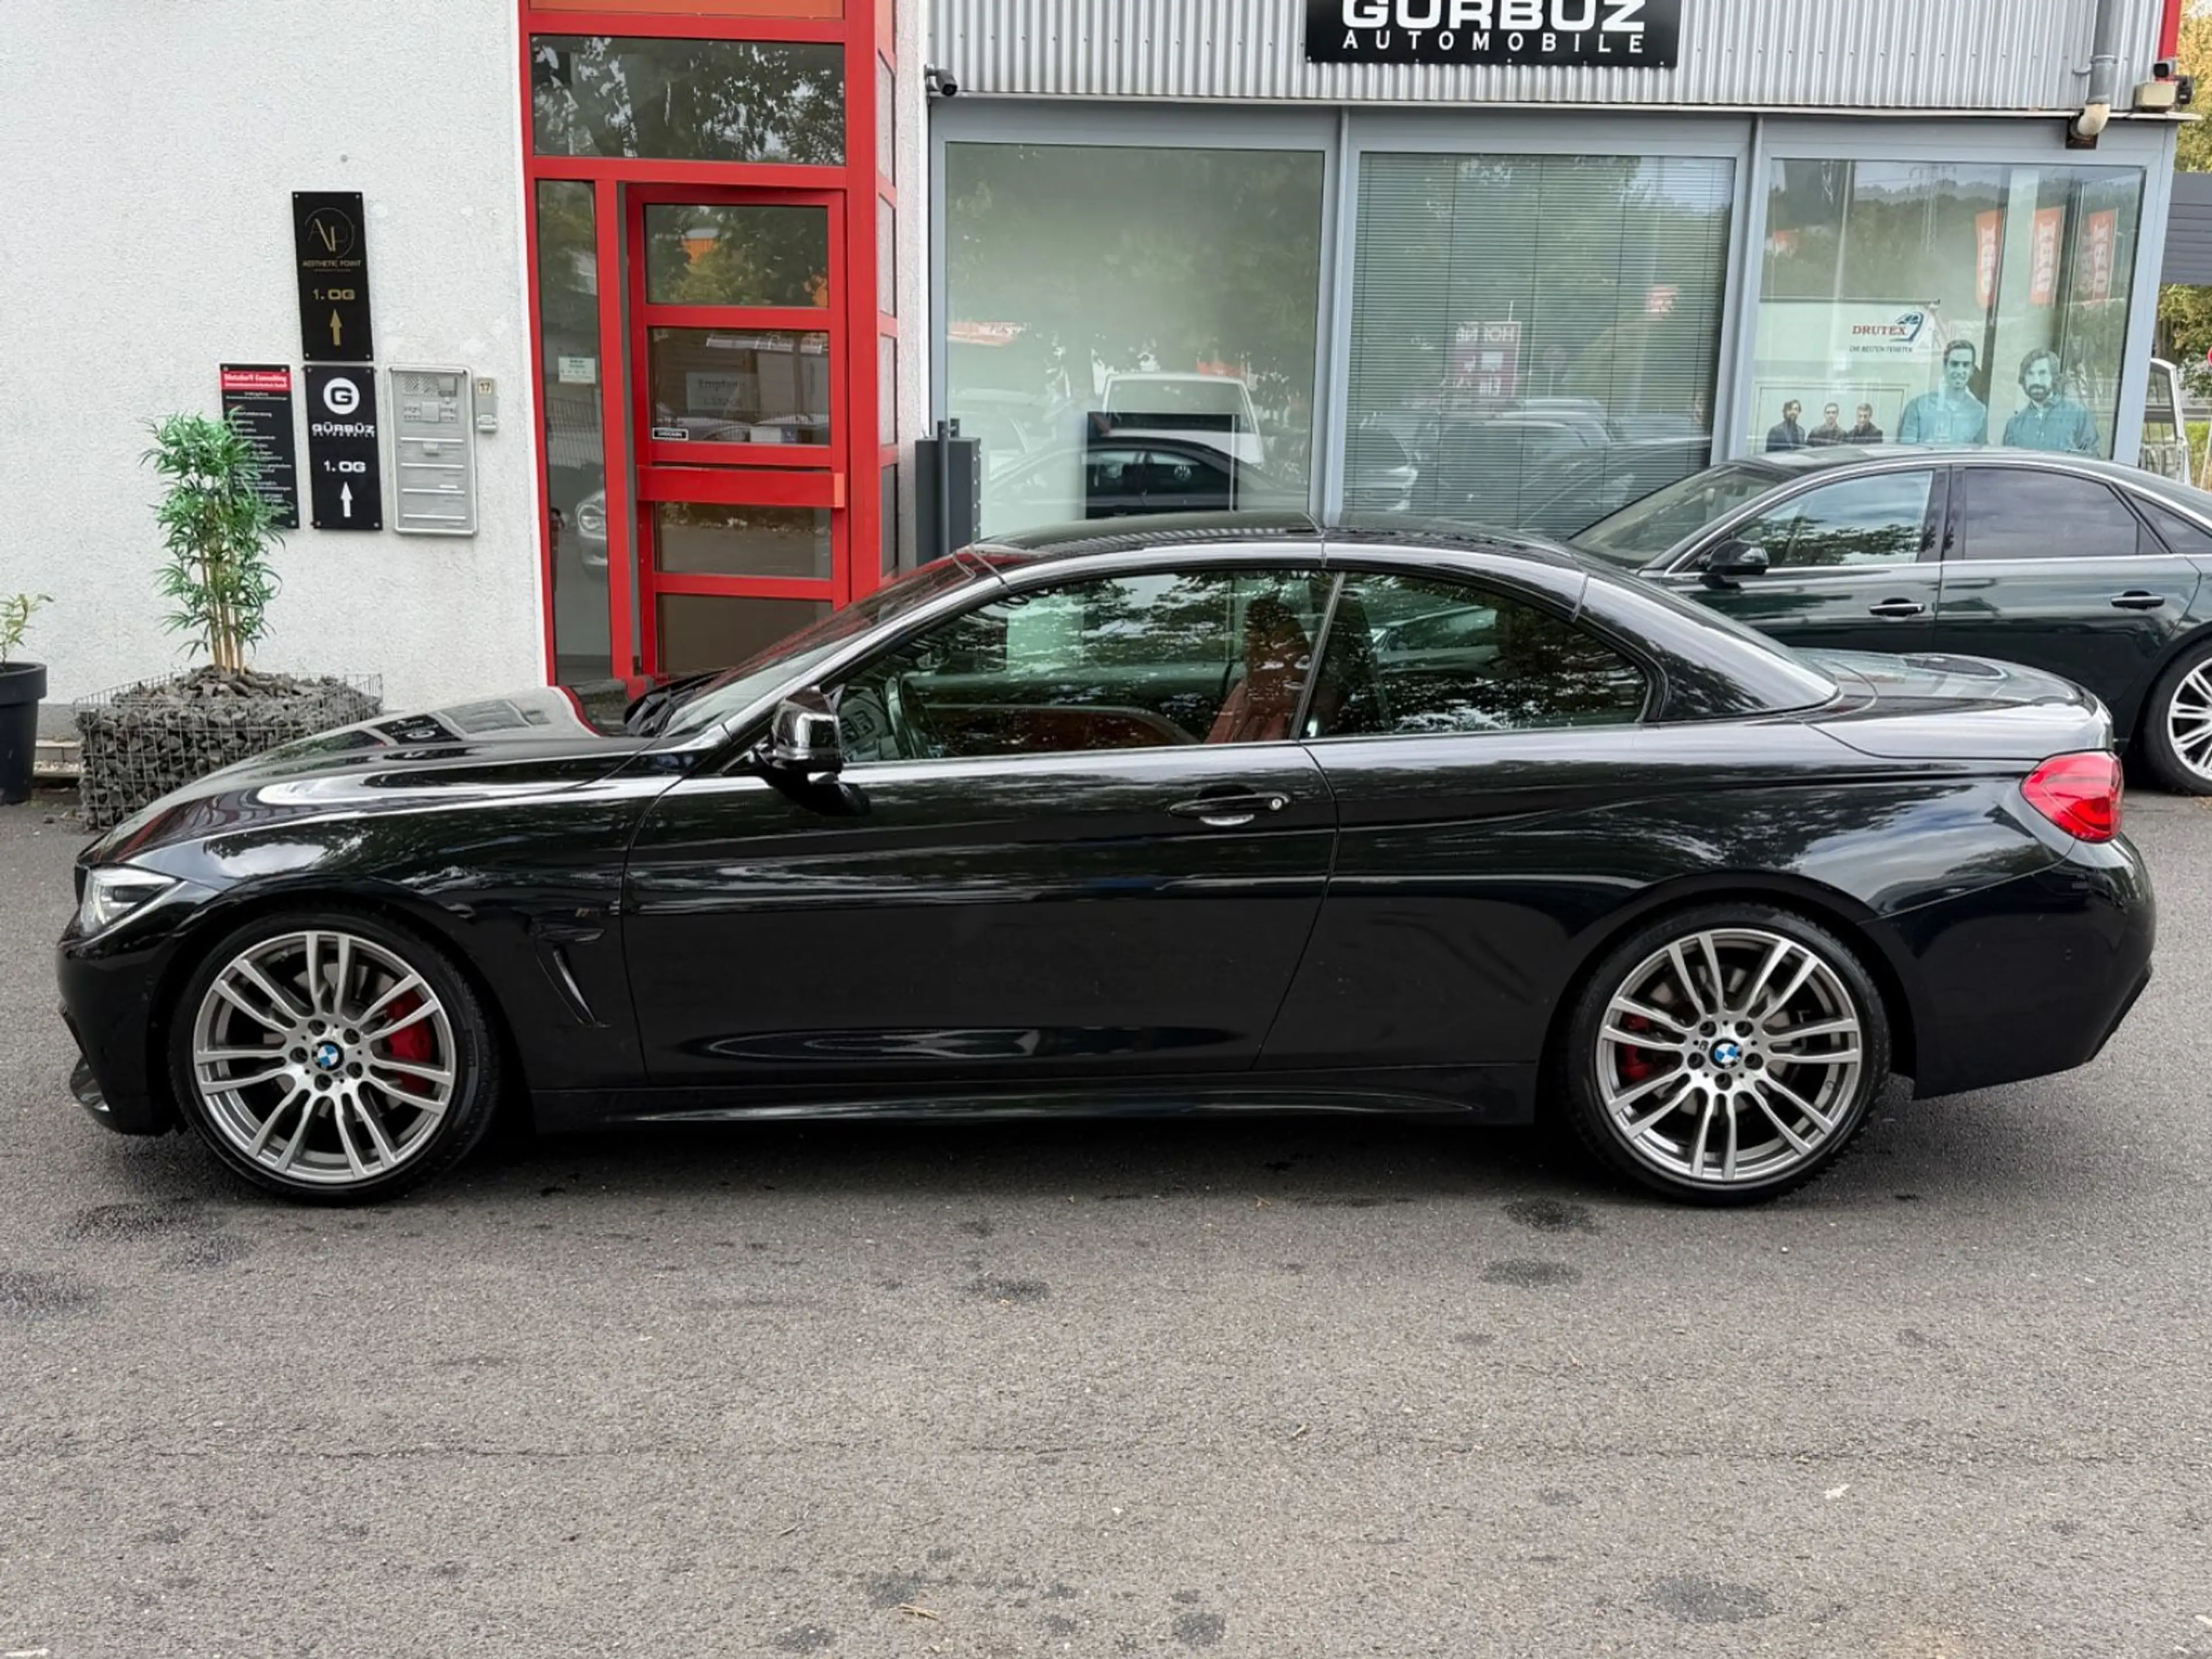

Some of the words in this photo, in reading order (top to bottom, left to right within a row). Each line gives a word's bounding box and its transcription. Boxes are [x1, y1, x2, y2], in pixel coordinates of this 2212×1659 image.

[1342, 29, 1644, 53] AUTOMOBILE
[313, 289, 324, 300] 1.
[327, 289, 355, 300] OG
[1851, 325, 1907, 335] DRUTEX
[331, 387, 353, 406] G
[324, 460, 336, 472] 1.
[339, 461, 366, 473] OG
